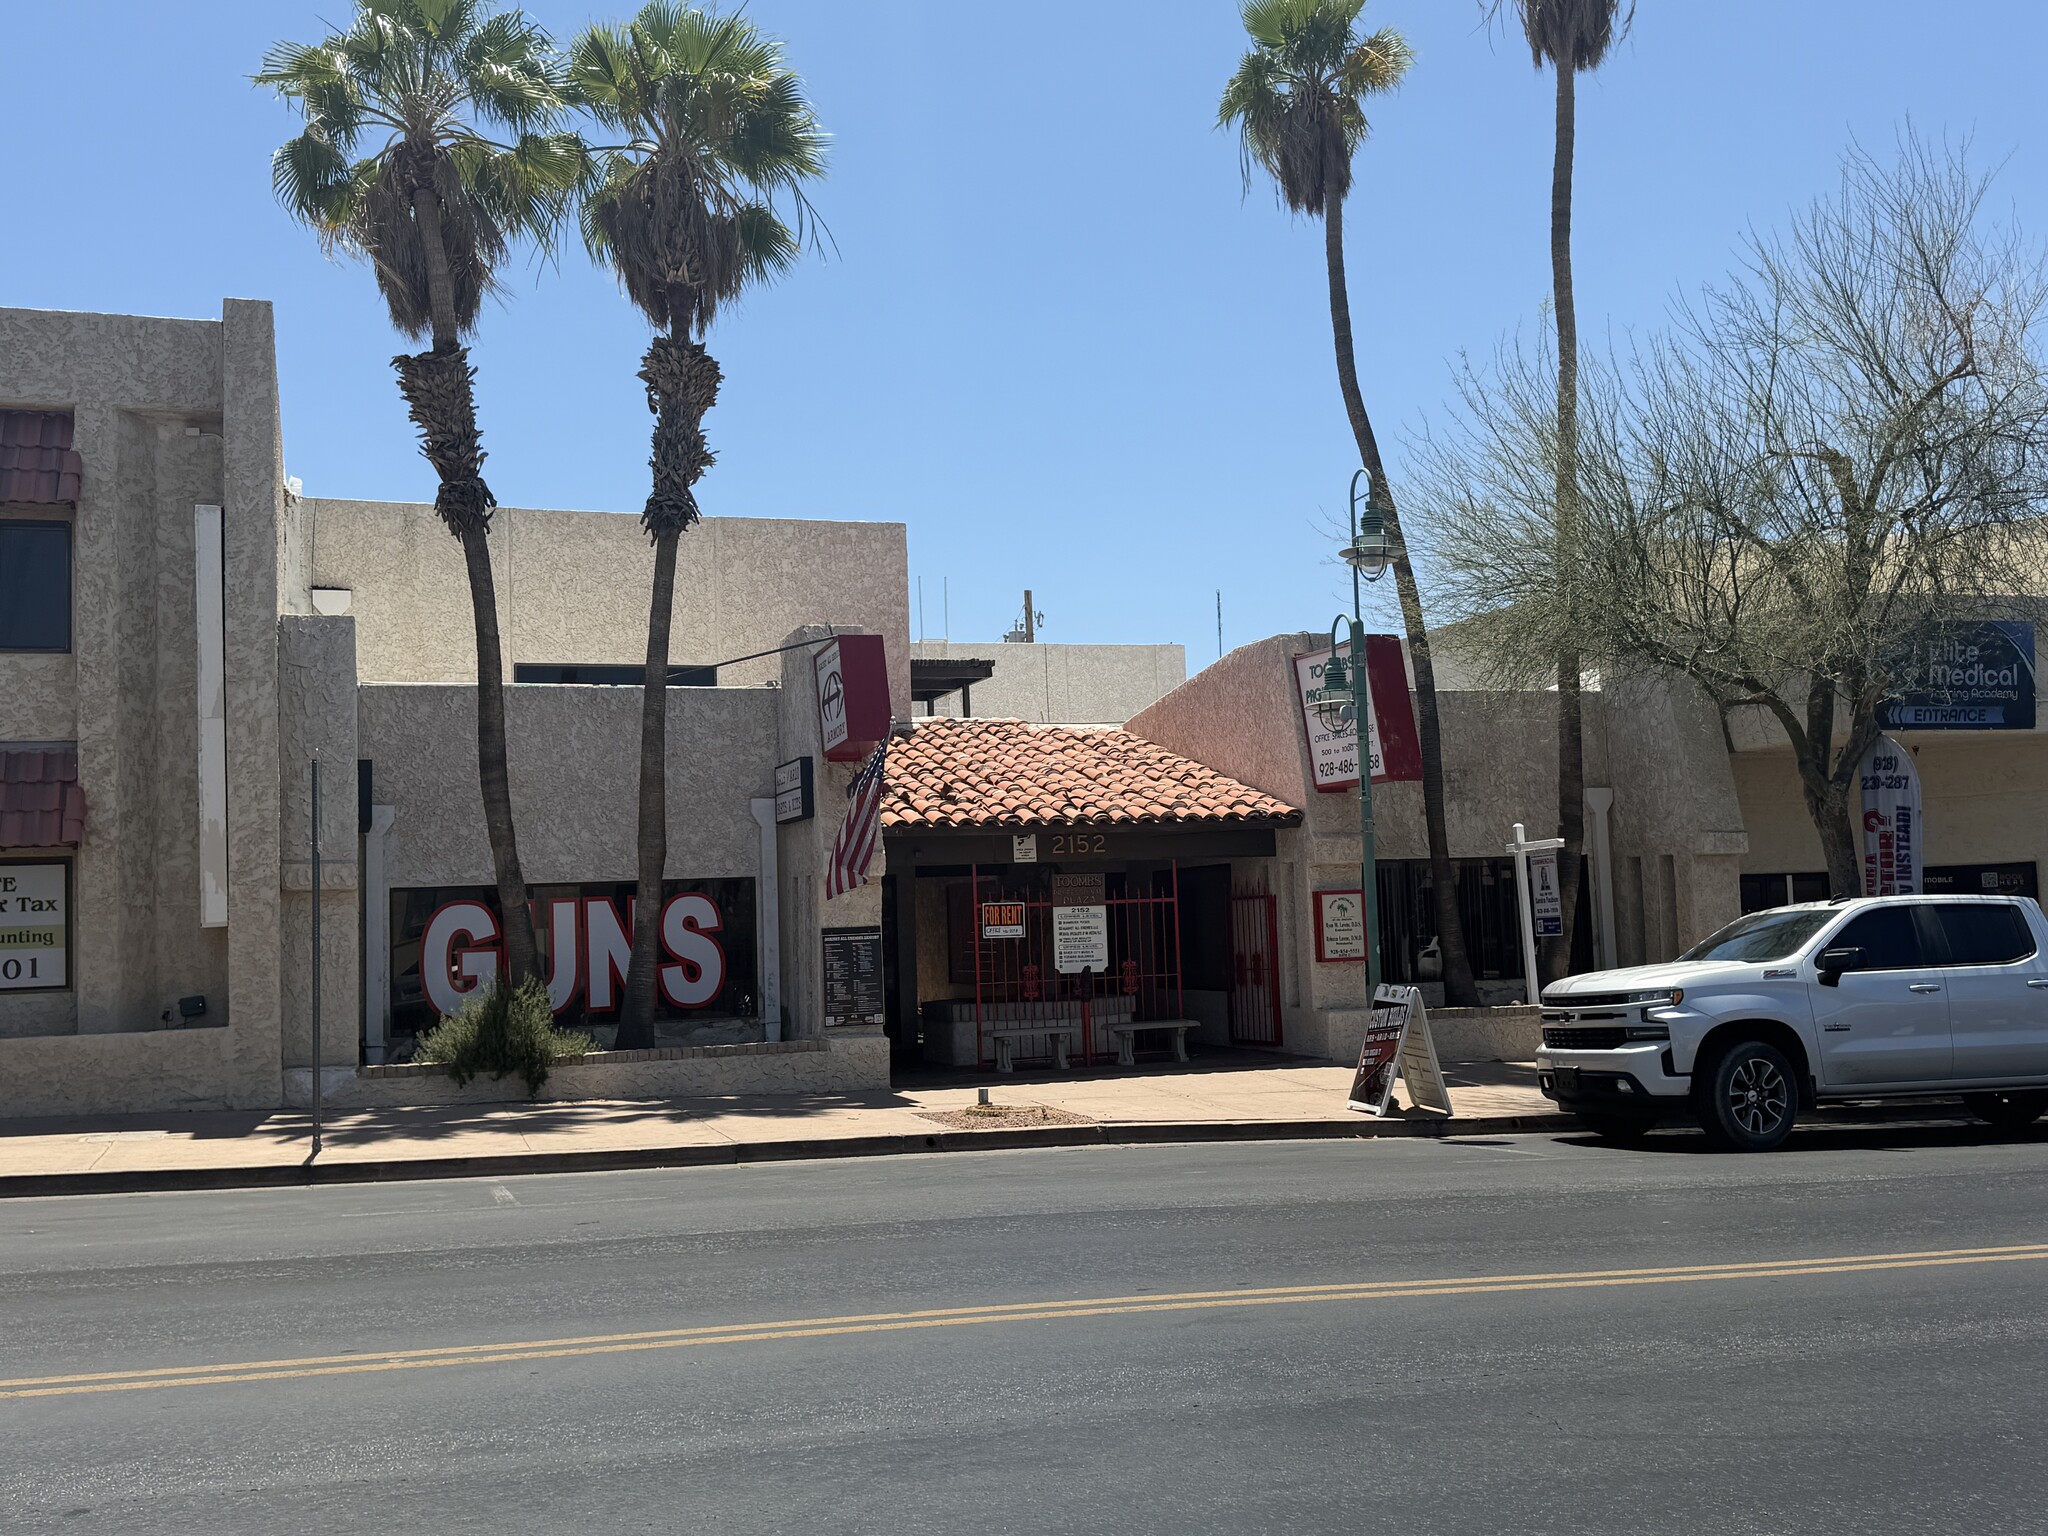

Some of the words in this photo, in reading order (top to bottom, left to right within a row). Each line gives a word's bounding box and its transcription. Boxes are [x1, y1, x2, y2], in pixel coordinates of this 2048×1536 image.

[1309, 656, 1354, 679] TOOBS
[1929, 663, 2018, 686] Medical
[1914, 708, 1986, 722] ENTRANCE
[1314, 733, 1330, 743] OFFICE
[1319, 754, 1380, 778] 928-486-58
[1052, 834, 1106, 854] 2152
[1896, 805, 1912, 881] INSTEAD!
[1055, 875, 1102, 887] TOOMBS
[1924, 876, 1953, 884] MOBILE
[16, 897, 58, 912] Tax
[1063, 895, 1096, 904] PLAZA
[985, 905, 1000, 925] FOR
[1001, 905, 1022, 925] RENT
